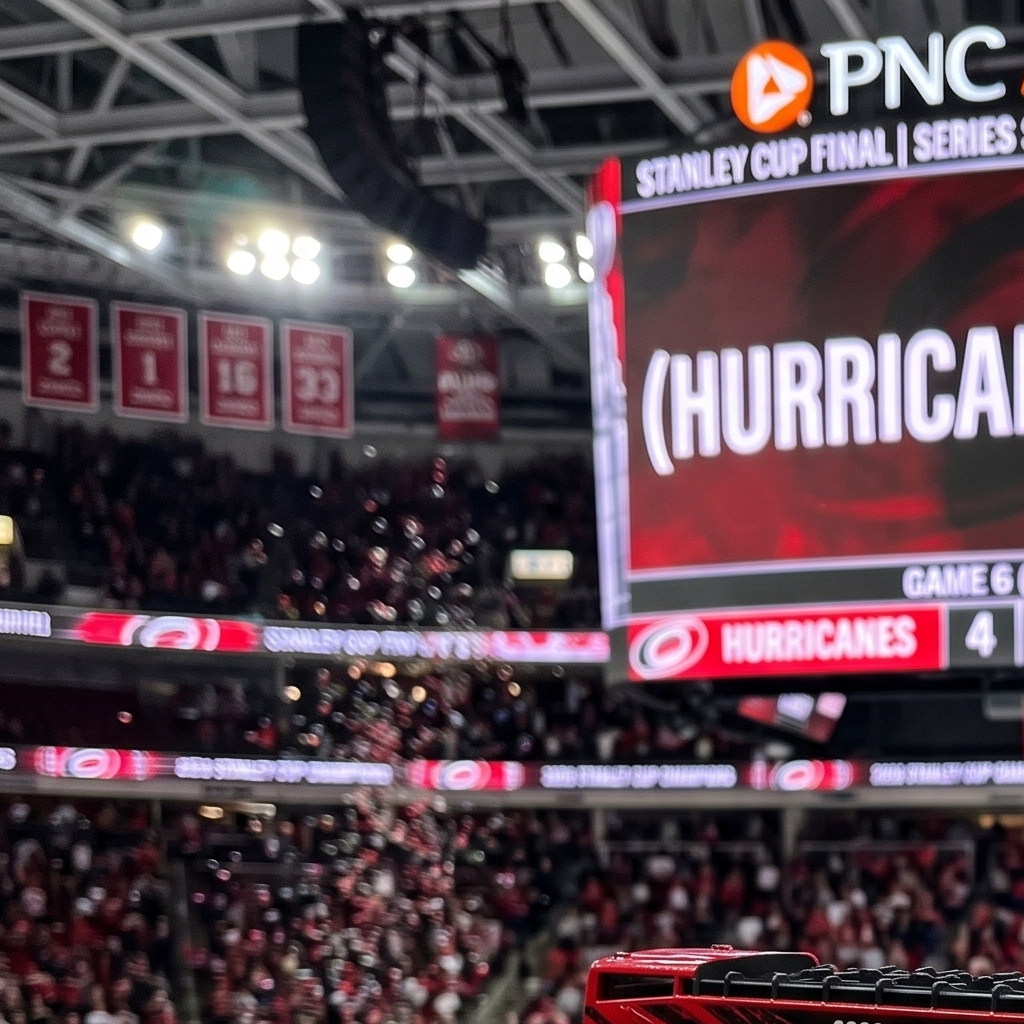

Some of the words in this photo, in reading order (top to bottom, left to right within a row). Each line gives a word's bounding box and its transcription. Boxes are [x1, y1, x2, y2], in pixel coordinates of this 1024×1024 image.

[820, 24, 1006, 115] PNC
[636, 143, 749, 198] STANLEY
[750, 136, 808, 181] CUP
[810, 126, 894, 173] FINAL
[913, 113, 1017, 162] SERIES
[902, 563, 989, 599] GAME
[990, 562, 1014, 596] 6
[721, 615, 918, 664] HURRICANES
[965, 610, 998, 658] 4
